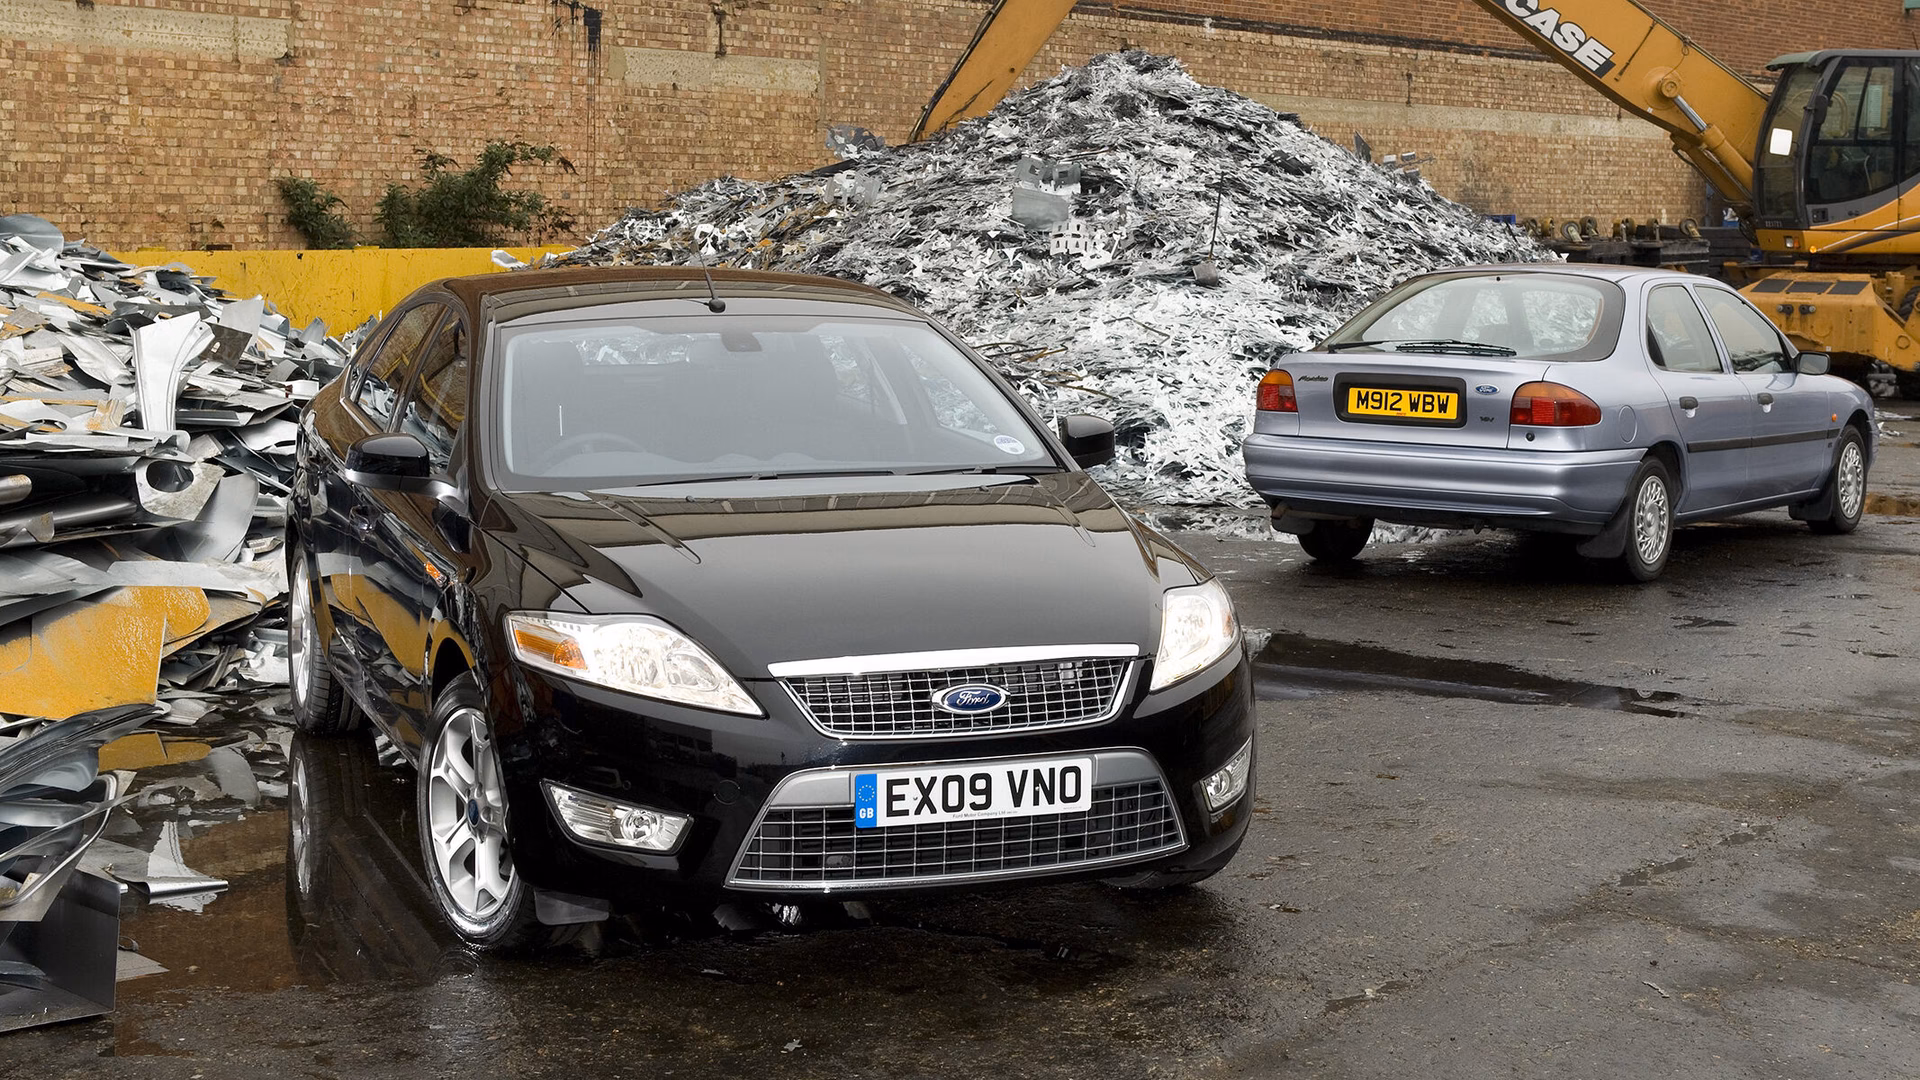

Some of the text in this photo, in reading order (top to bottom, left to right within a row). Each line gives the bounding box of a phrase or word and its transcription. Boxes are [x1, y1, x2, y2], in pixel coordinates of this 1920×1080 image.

[1505, 0, 1615, 72] CASE
[1356, 390, 1450, 414] M912 WBW
[956, 690, 990, 706] Ford
[886, 766, 1081, 817] EX09 VNO
[859, 807, 874, 819] GB
